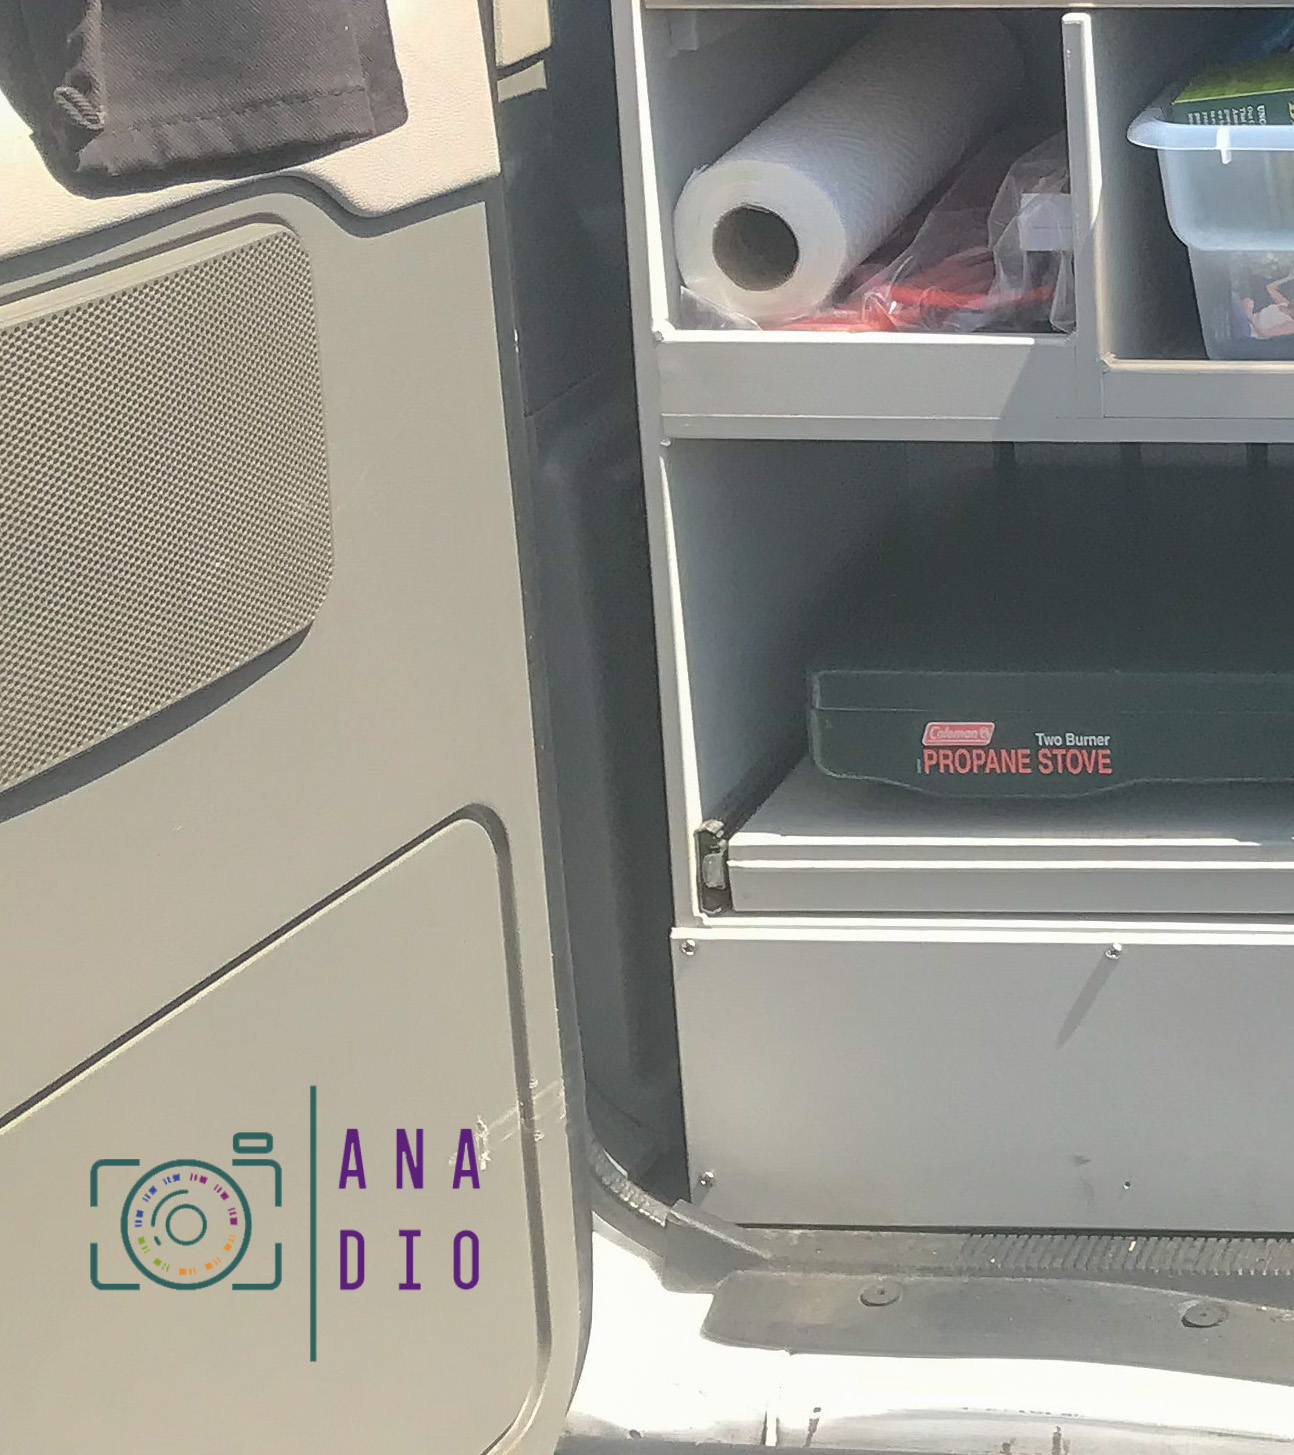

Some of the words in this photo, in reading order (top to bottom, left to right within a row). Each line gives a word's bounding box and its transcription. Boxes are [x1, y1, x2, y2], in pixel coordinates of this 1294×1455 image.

[929, 726, 978, 740] Coleman
[1035, 732, 1063, 747] Two
[1066, 732, 1111, 747] Burner
[923, 748, 1032, 775] PROPANE
[1037, 748, 1113, 775] STOVE
